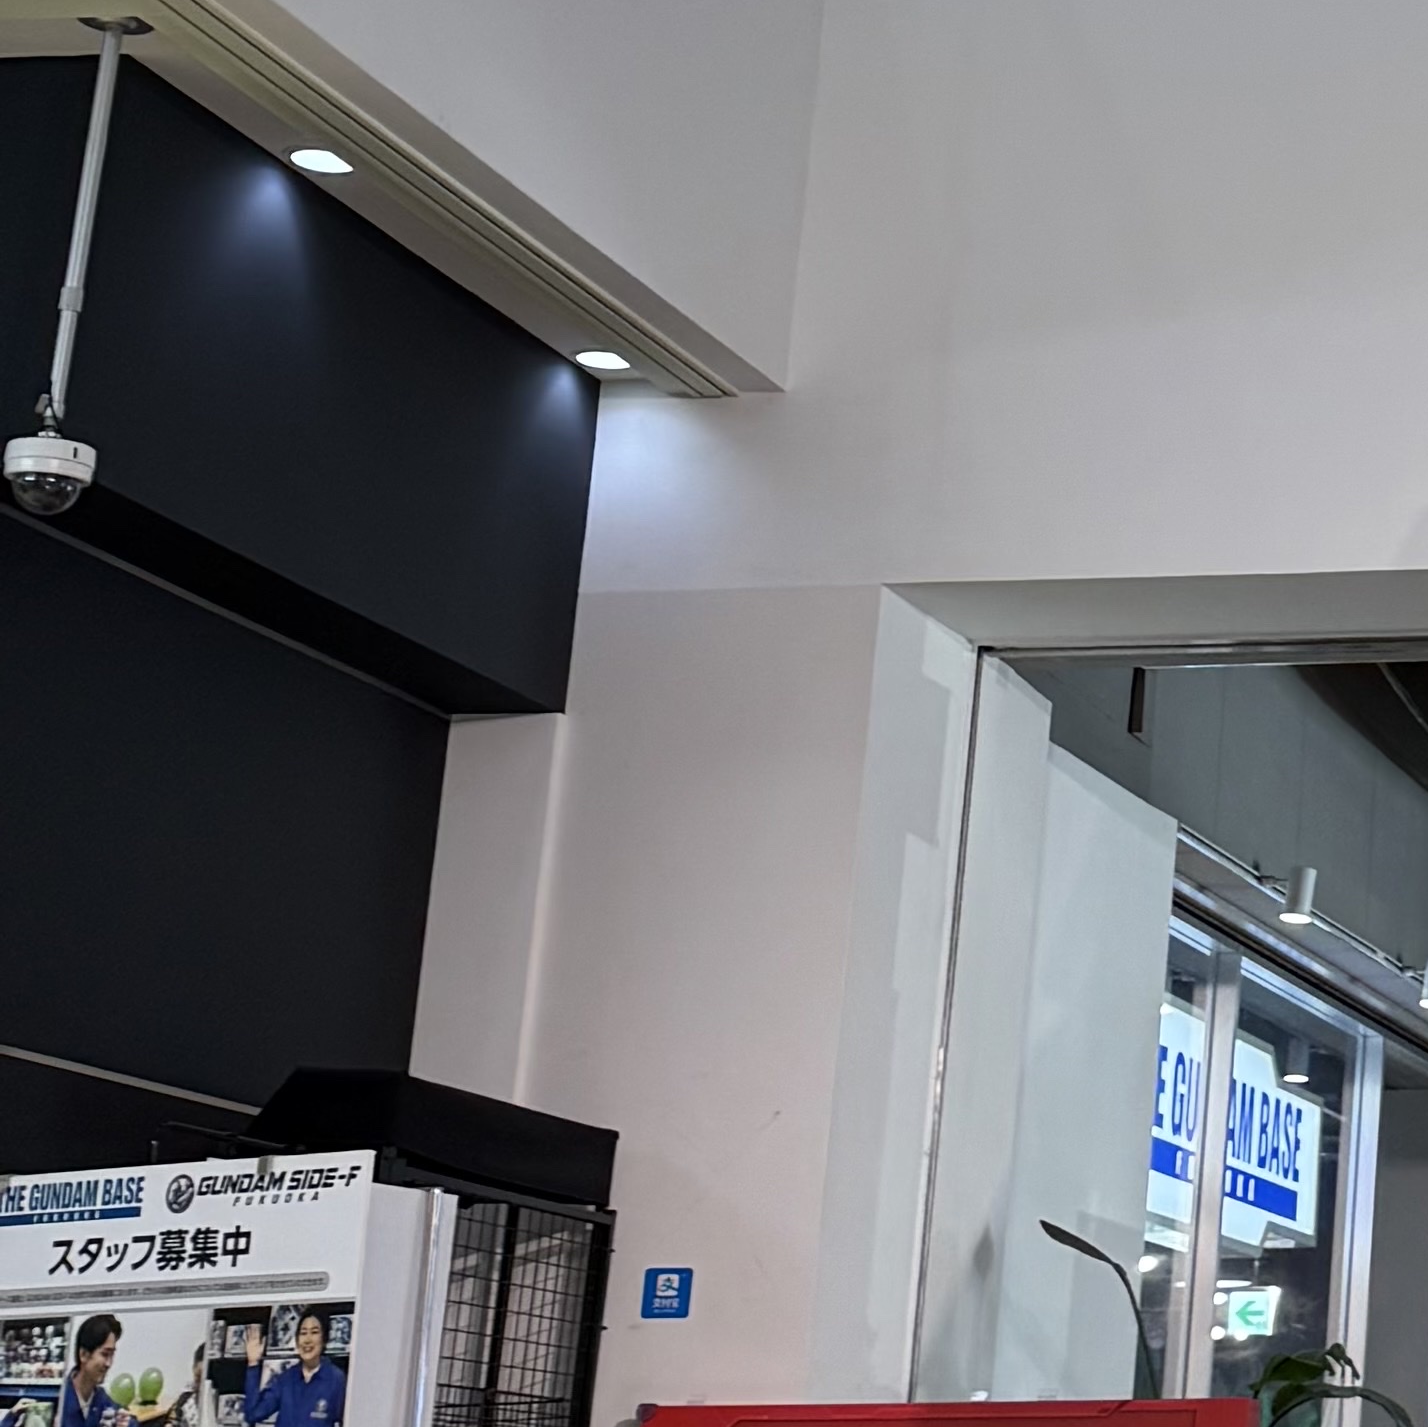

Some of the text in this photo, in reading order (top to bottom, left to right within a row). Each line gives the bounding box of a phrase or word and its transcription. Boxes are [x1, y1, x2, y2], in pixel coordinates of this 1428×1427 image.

[1258, 1091, 1303, 1184] BASE
[29, 1179, 99, 1213] GUNDAM
[102, 1175, 146, 1206] BASE
[197, 1165, 363, 1198] GUNDAM SIDE-F
[48, 1224, 253, 1277] スタッフ募集中
